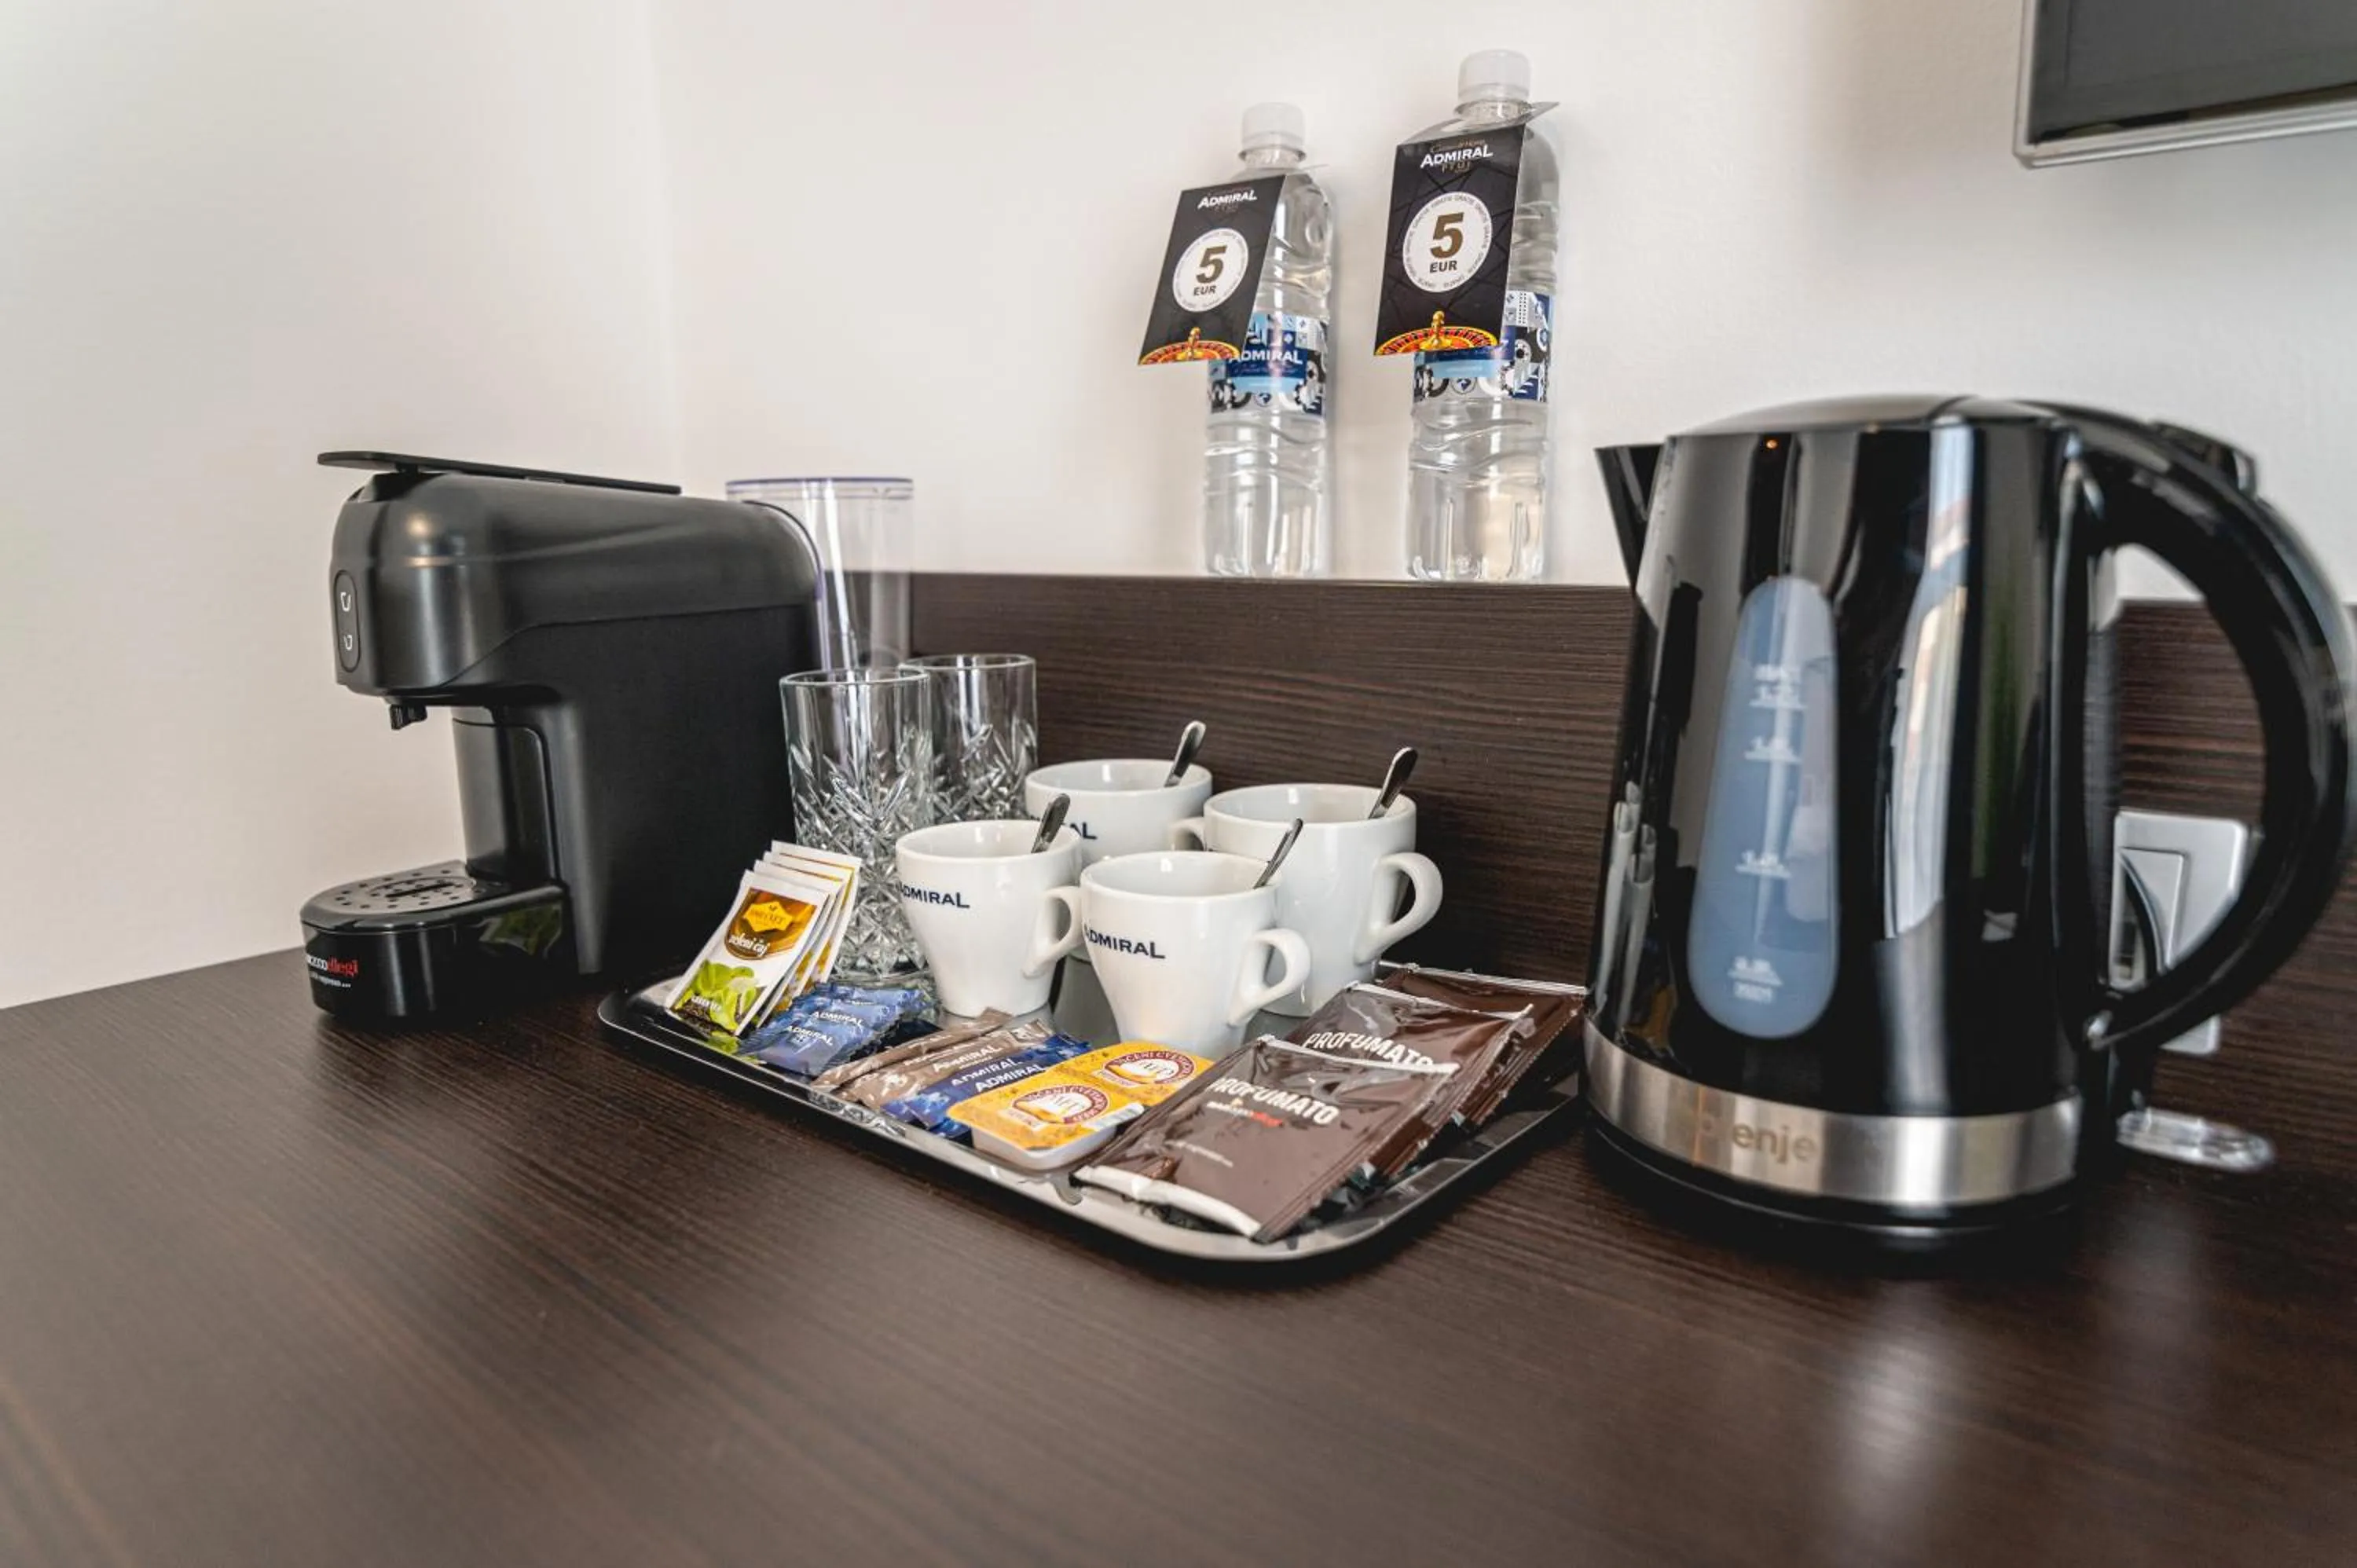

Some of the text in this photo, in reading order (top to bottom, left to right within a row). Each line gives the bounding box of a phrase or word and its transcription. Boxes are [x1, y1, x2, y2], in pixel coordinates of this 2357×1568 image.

[1420, 145, 1493, 168] ADMIRAL
[1197, 189, 1257, 209] ADMIRAL
[1430, 211, 1464, 259] 5
[1196, 244, 1227, 284] 5
[1429, 260, 1458, 274] EUR
[1193, 285, 1217, 296] EUR
[974, 1063, 1048, 1093] ADMIRAL
